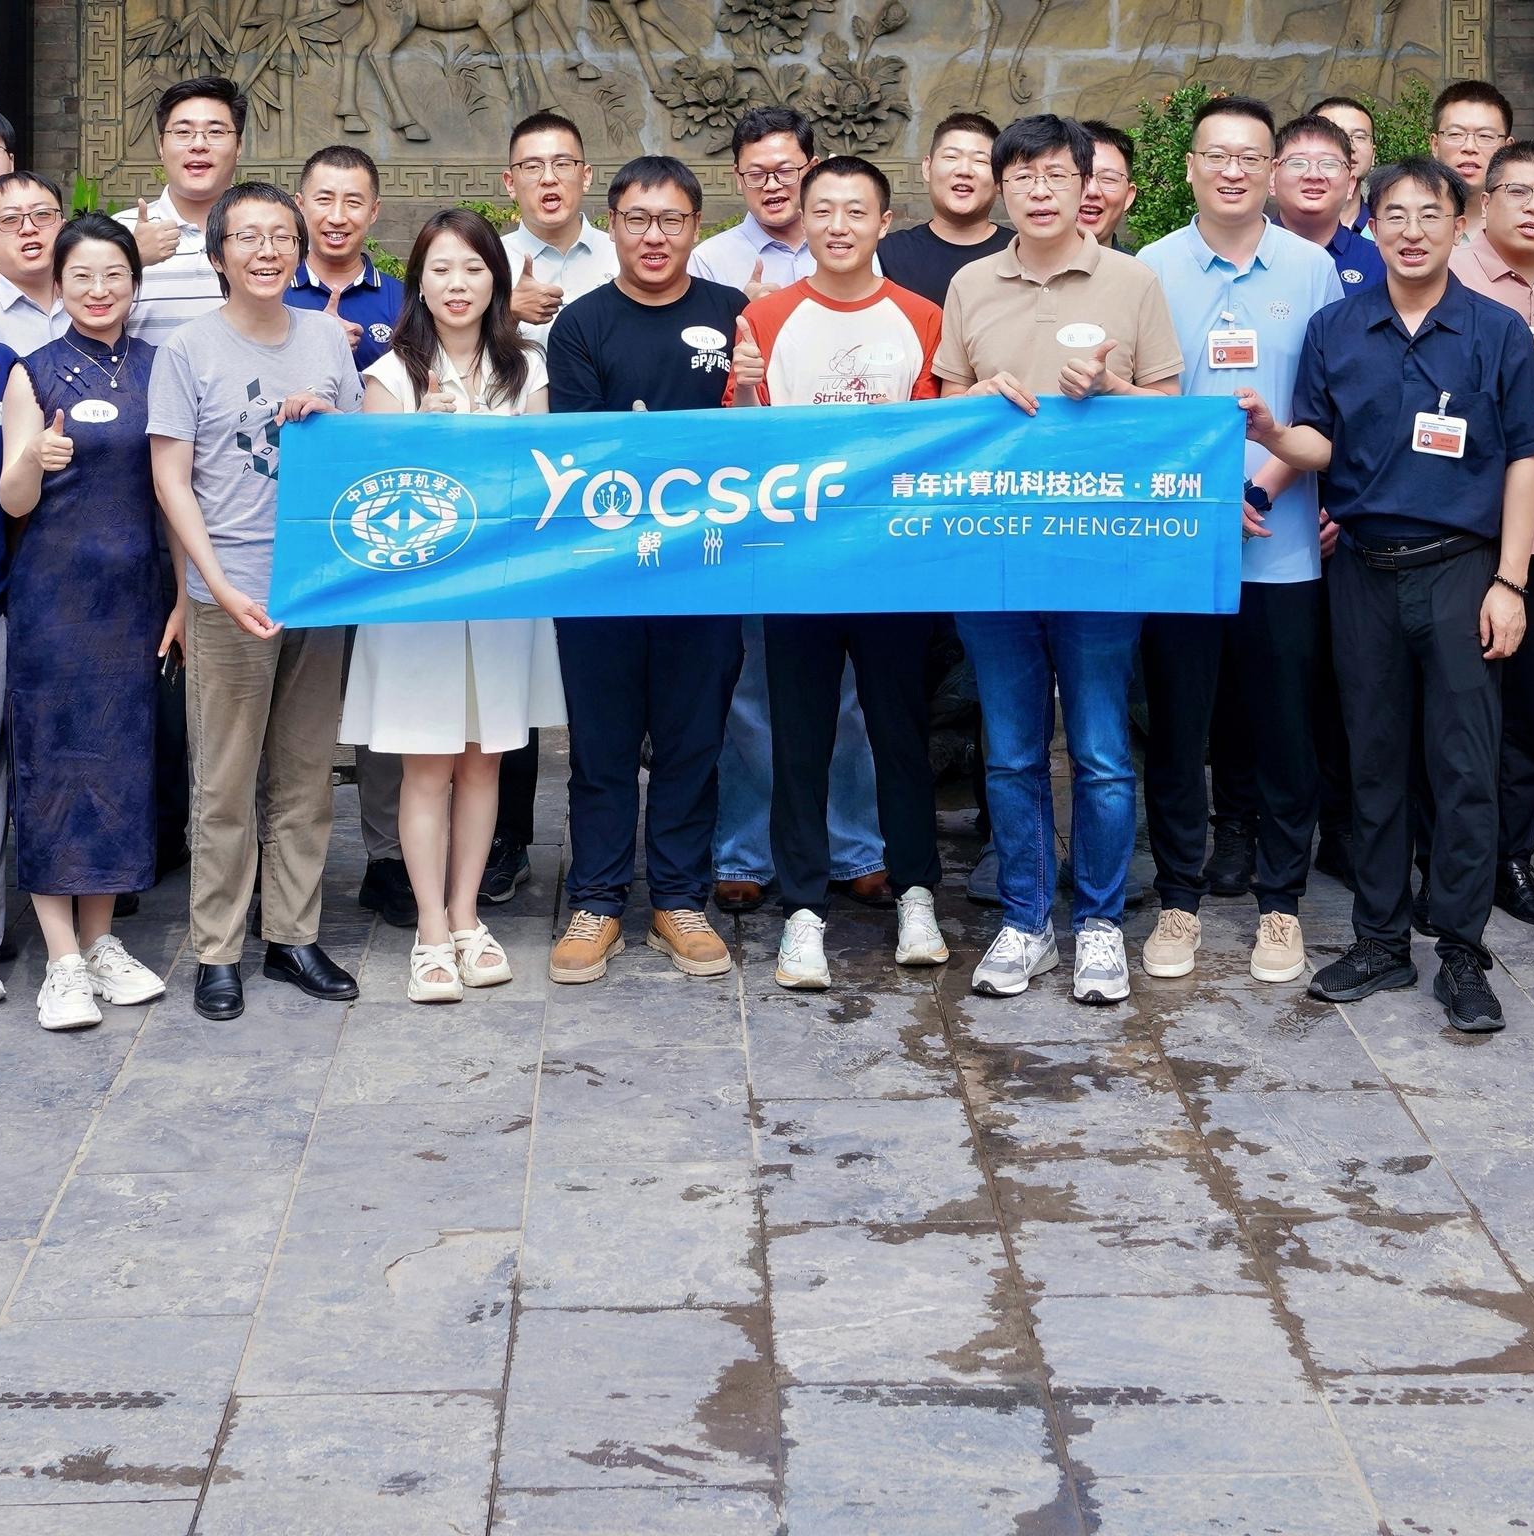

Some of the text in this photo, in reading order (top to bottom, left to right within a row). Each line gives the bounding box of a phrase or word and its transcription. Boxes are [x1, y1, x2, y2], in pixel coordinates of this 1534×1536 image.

[813, 392, 852, 405] Strike
[346, 472, 463, 505] 中国计算机学会
[530, 448, 848, 532] YOCSEF
[887, 516, 1199, 539] CCF YOCSEF ZHENGZHOU
[367, 545, 437, 567] CCF
